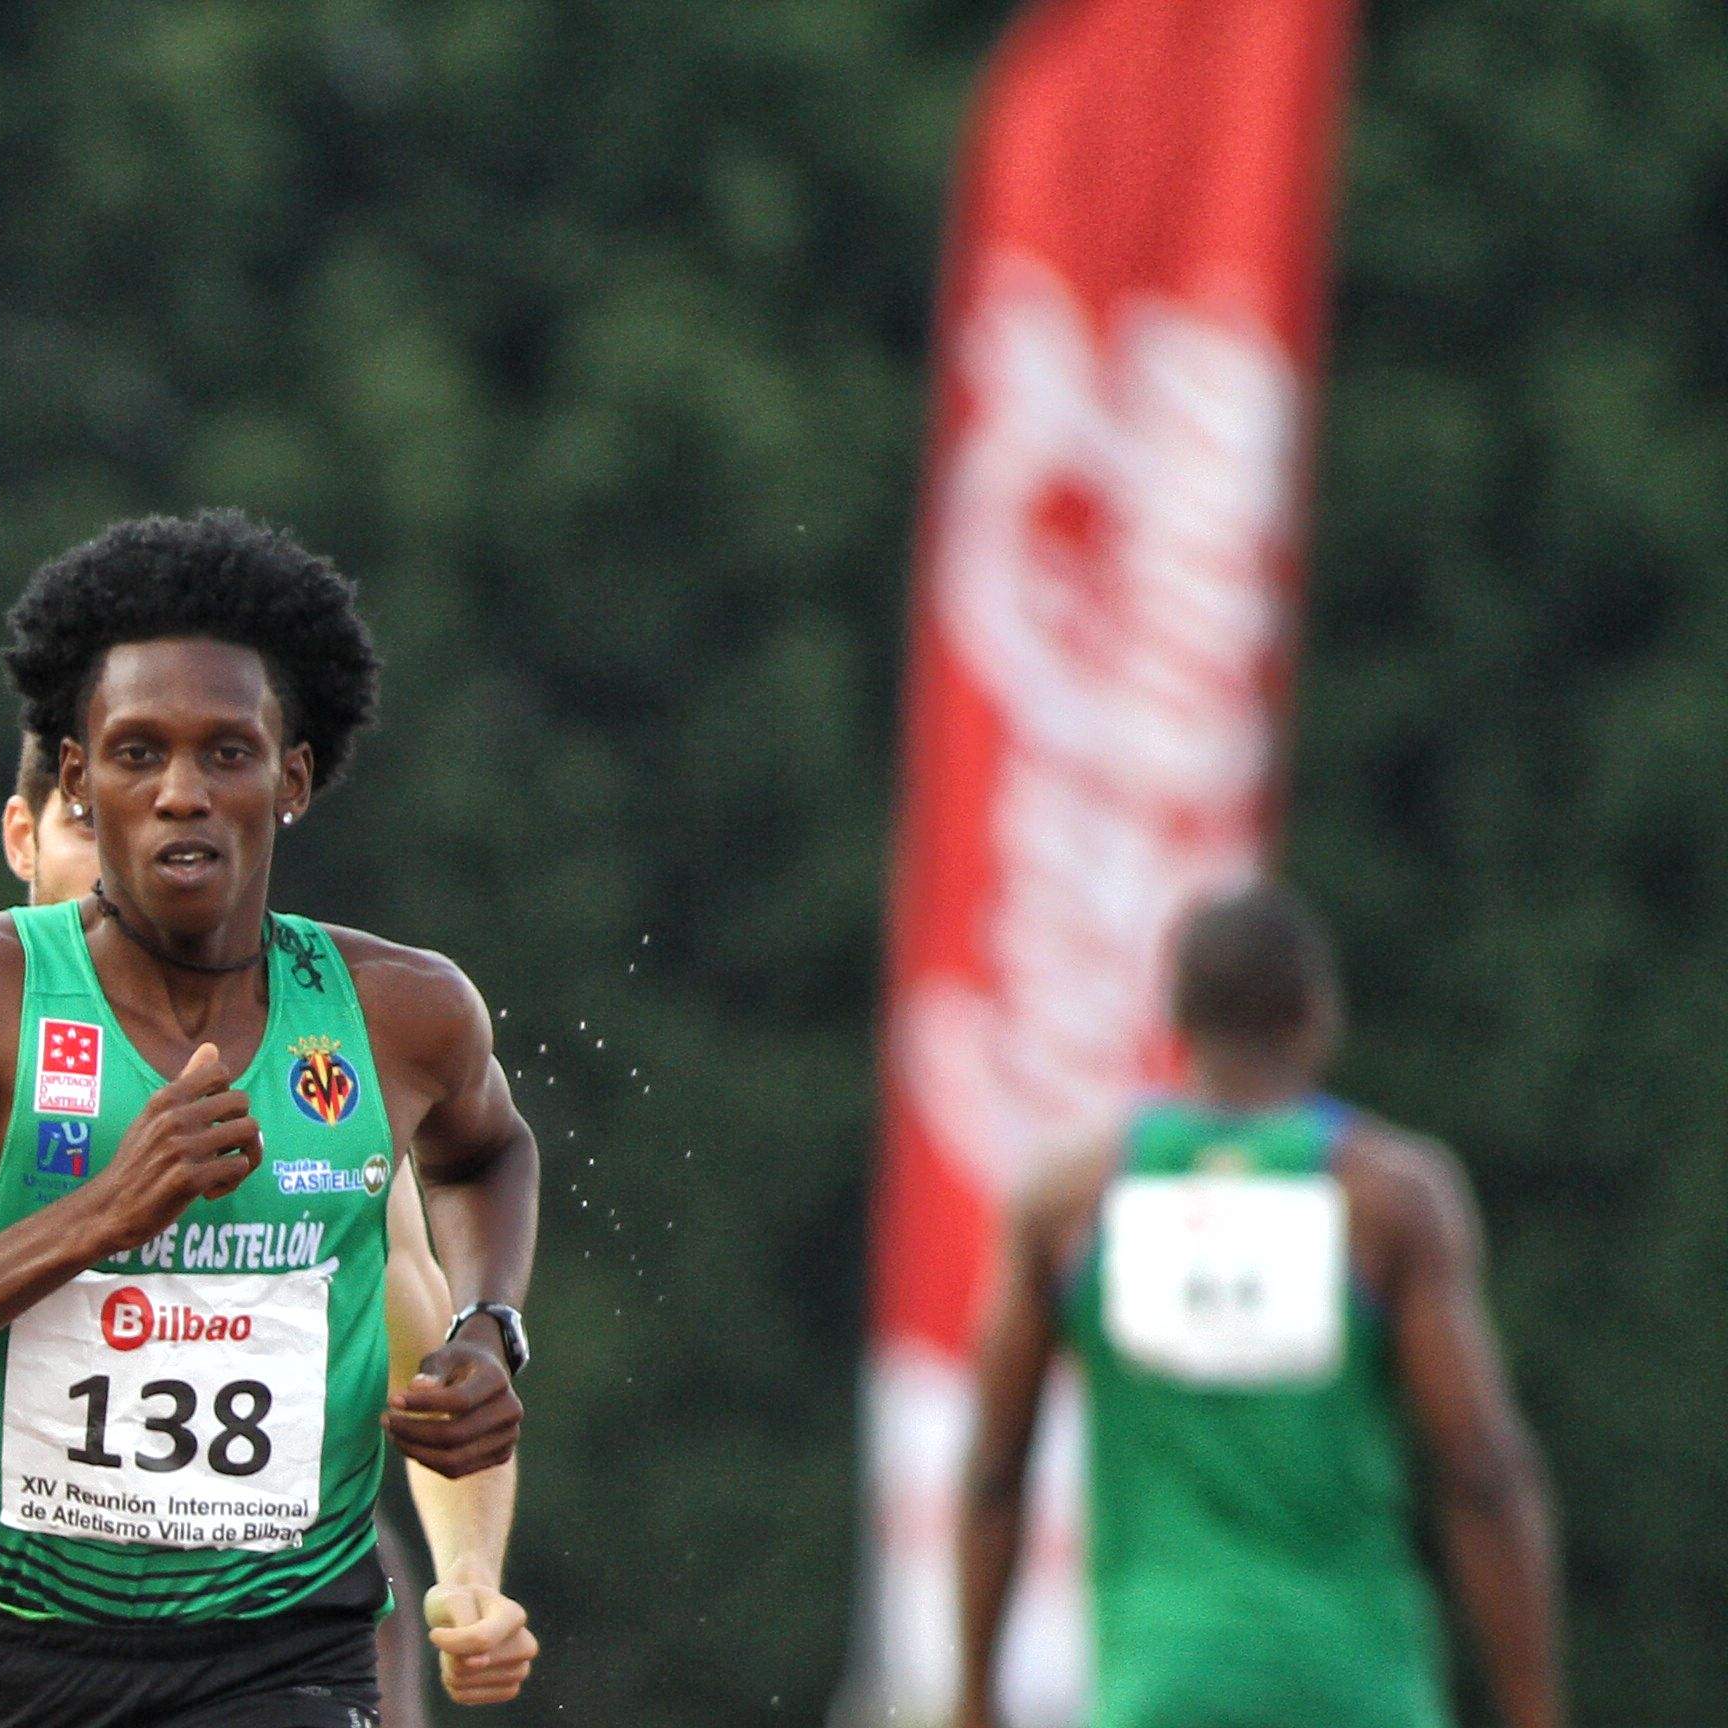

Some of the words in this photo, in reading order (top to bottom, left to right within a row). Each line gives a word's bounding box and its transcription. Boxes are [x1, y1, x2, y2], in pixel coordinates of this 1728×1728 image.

[182, 1210, 325, 1269] CASTELLÓN
[102, 1290, 253, 1350] Bilbao
[67, 1375, 273, 1477] 138
[20, 1500, 47, 1520] de
[52, 1505, 151, 1539] Atletismo
[158, 1519, 205, 1541] Villa
[211, 1523, 238, 1541] de
[21, 1475, 57, 1496] XIV
[66, 1483, 156, 1515] Reunión
[168, 1496, 309, 1518] Internacional
